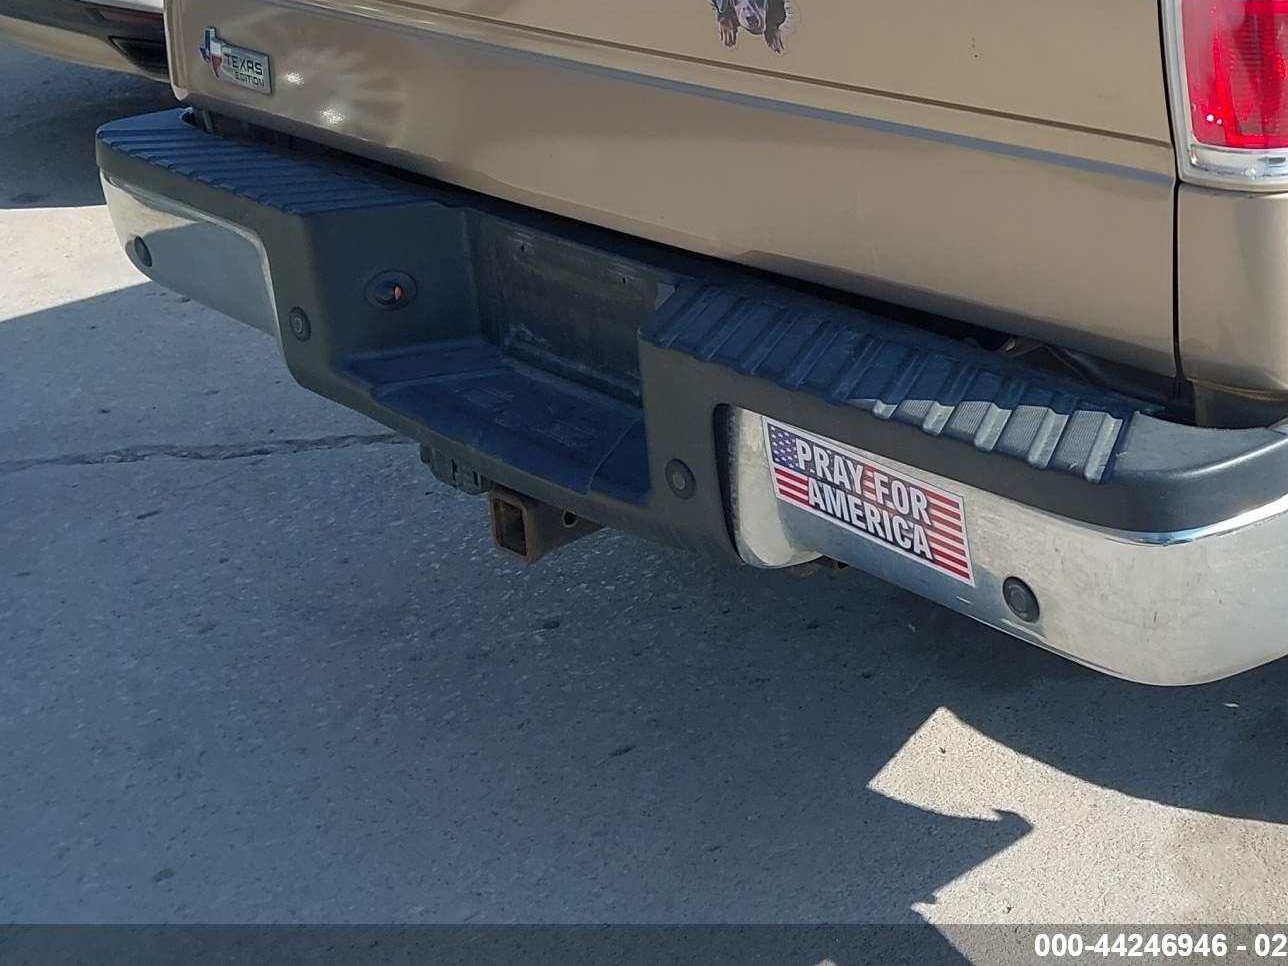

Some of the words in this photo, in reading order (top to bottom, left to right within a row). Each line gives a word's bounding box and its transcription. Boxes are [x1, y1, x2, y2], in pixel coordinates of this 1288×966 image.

[223, 52, 263, 76] TEXAS
[234, 70, 265, 87] EDITION
[795, 437, 864, 496] PRAY
[873, 471, 932, 525] FOR
[808, 477, 934, 561] AMERICA
